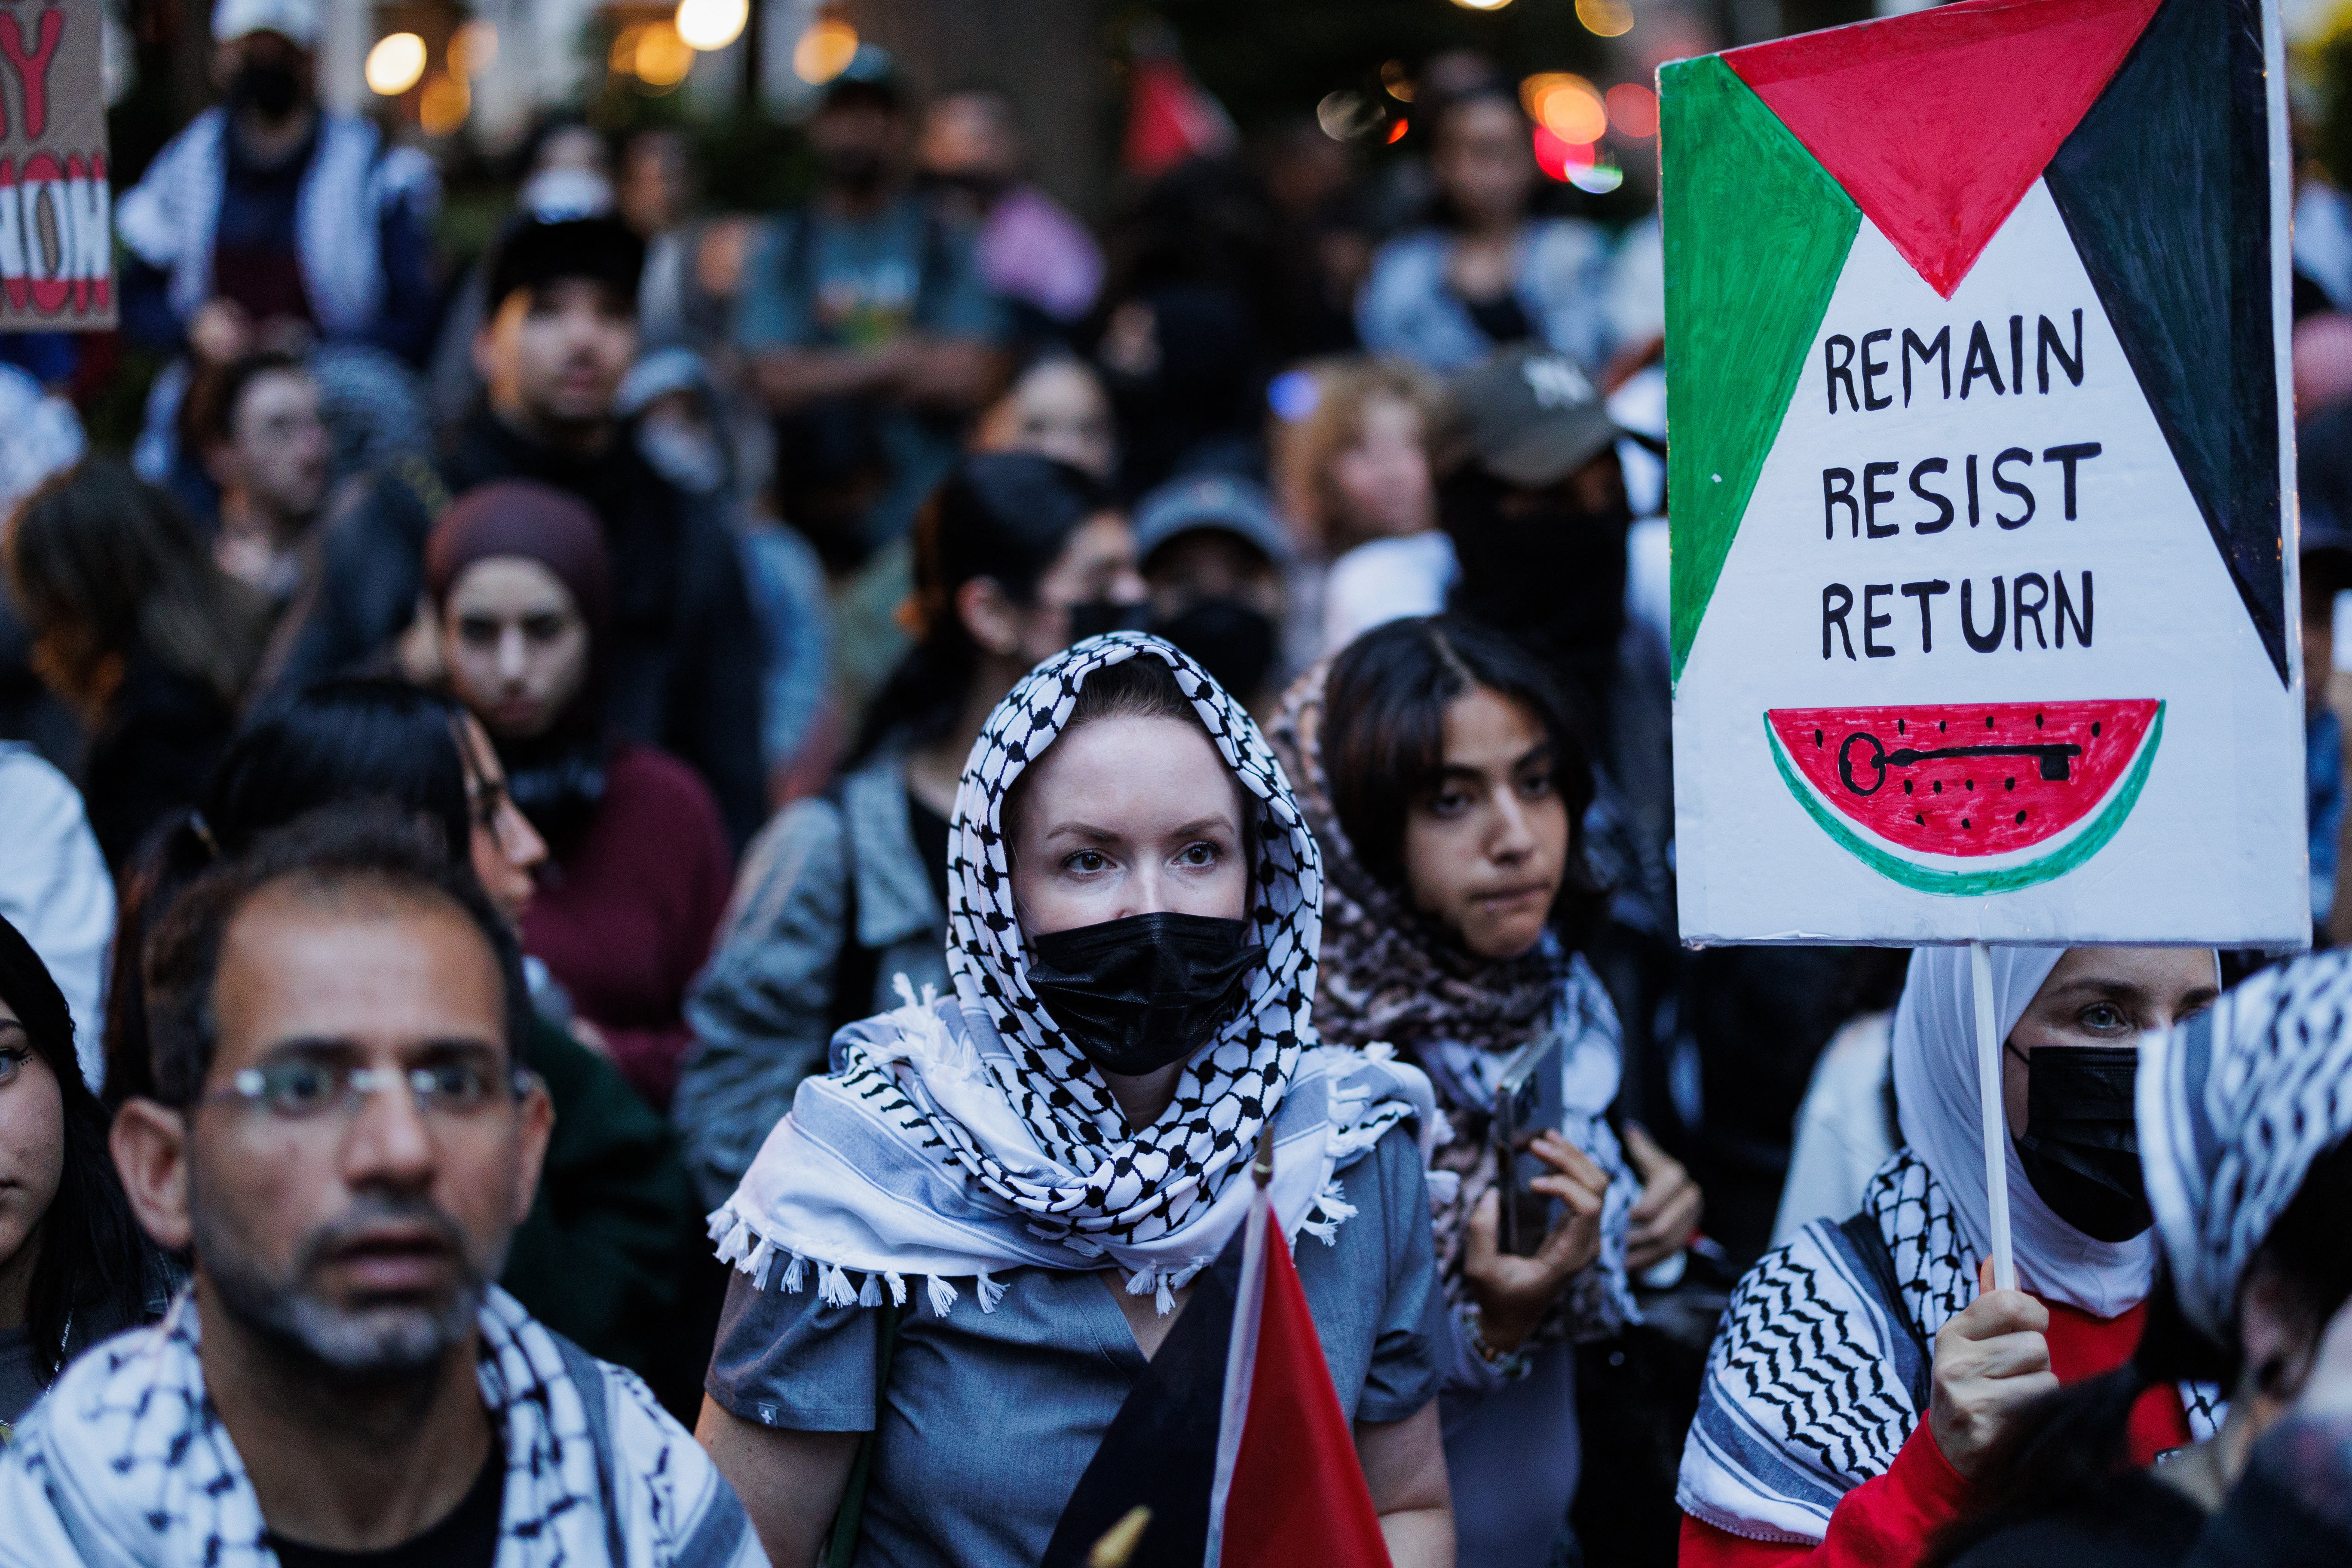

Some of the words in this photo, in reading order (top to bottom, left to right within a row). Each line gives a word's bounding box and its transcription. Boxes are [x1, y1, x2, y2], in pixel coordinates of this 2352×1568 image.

[0, 8, 64, 141] Y
[1825, 308, 2084, 415] REMAIN
[1822, 442, 2102, 540] RESIST
[1822, 570, 2094, 662] RETURN
